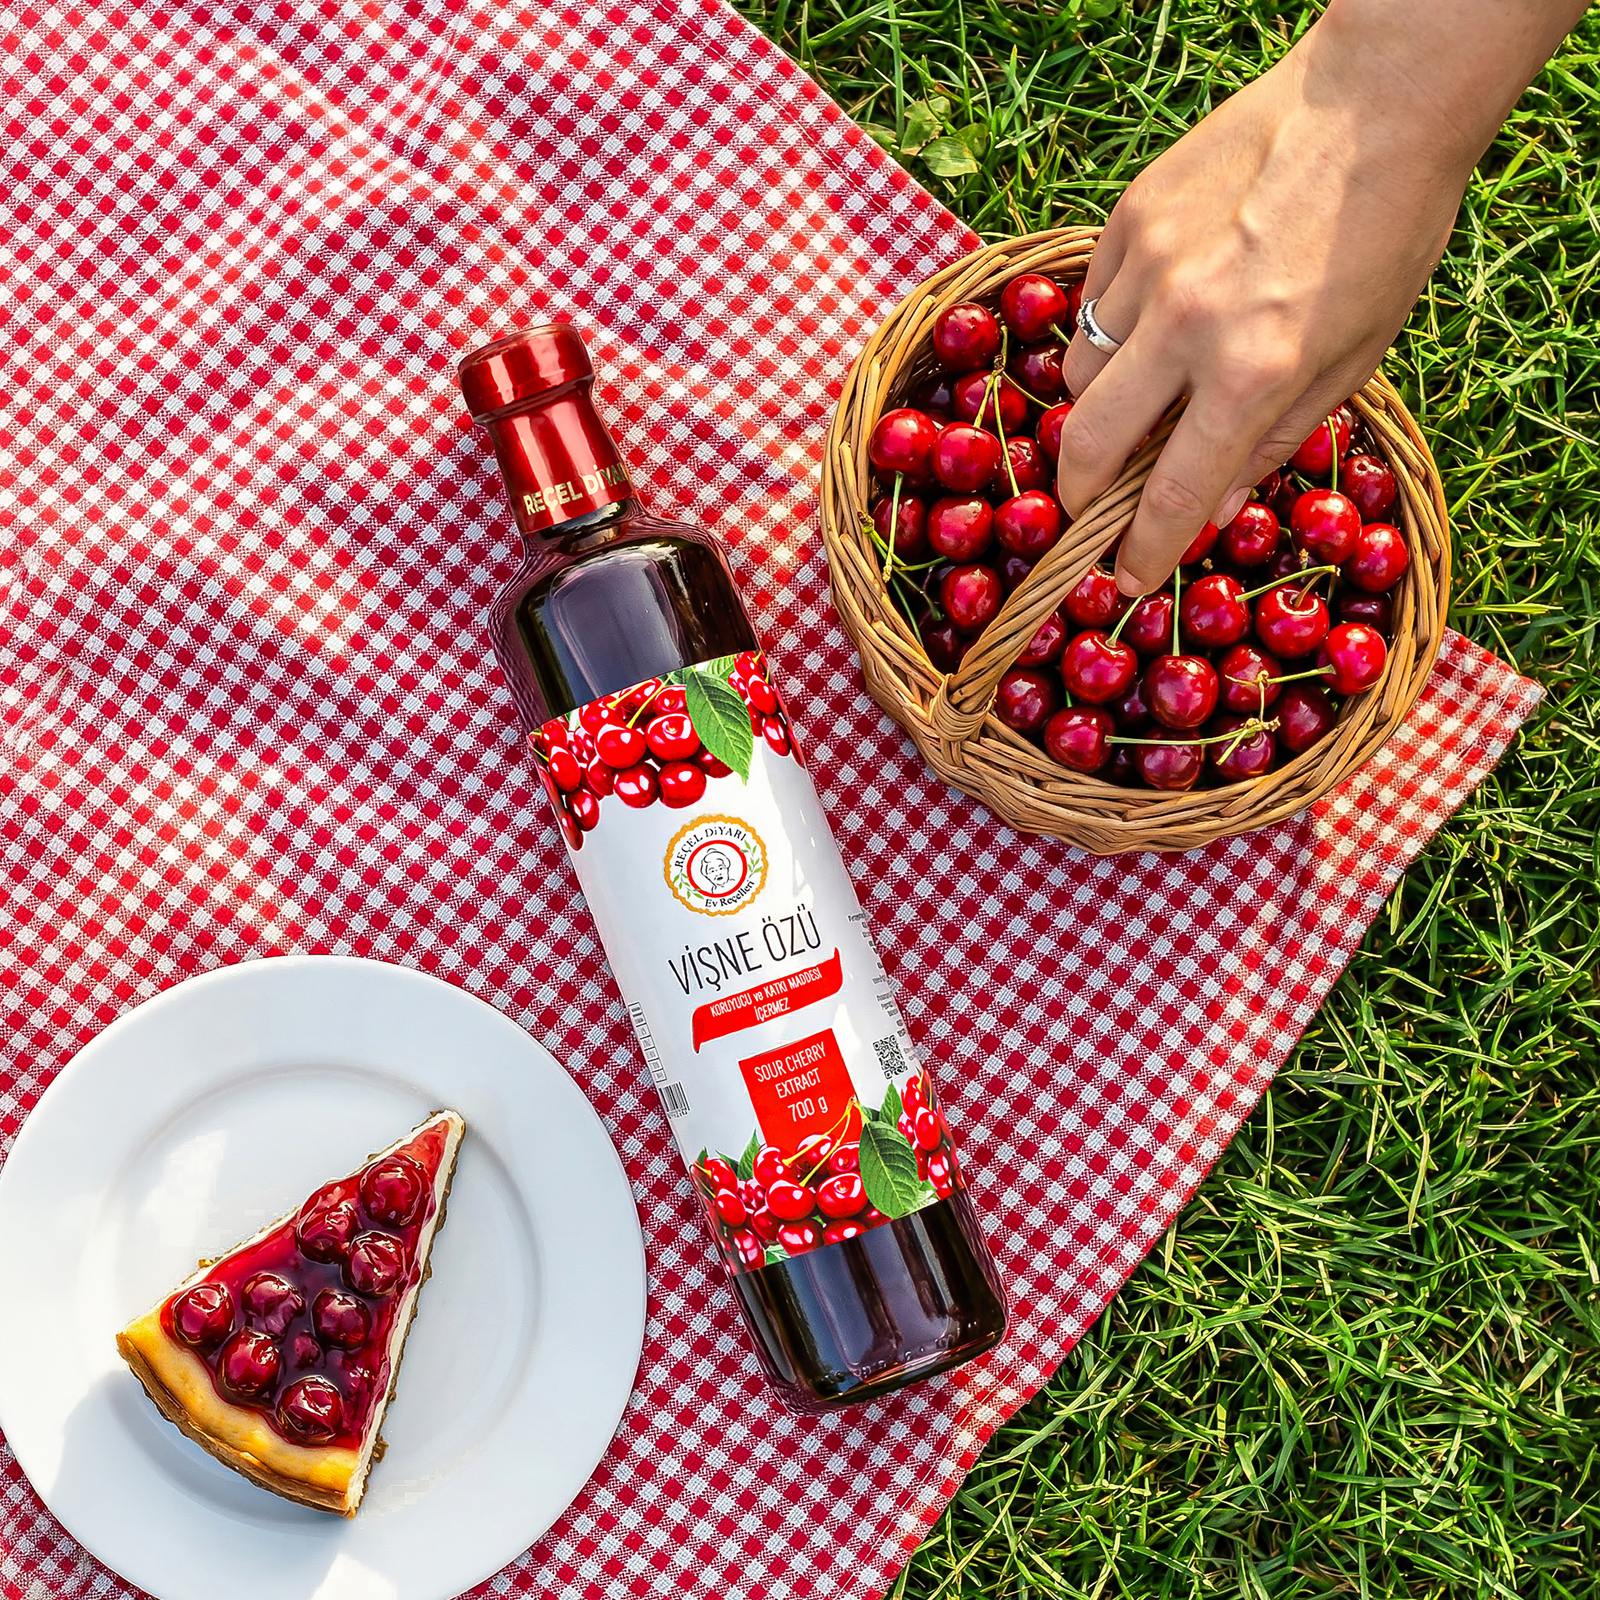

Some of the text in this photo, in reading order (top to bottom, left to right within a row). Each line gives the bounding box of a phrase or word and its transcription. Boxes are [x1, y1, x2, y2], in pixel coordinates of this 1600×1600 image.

[523, 481, 583, 516] REÇEL
[675, 834, 704, 868] REÇEL
[705, 898, 718, 908] Ev
[667, 903, 821, 995] VİŞNE ÖZÜ
[710, 992, 753, 1018] KORUYUCU
[753, 991, 764, 1003] ve
[763, 980, 788, 999] KATKI
[754, 997, 791, 1022] İÇERMEZ
[753, 1041, 826, 1083] SOUR CHERRY
[775, 1067, 822, 1099] EXTRACT
[787, 1096, 828, 1122] 700 g
